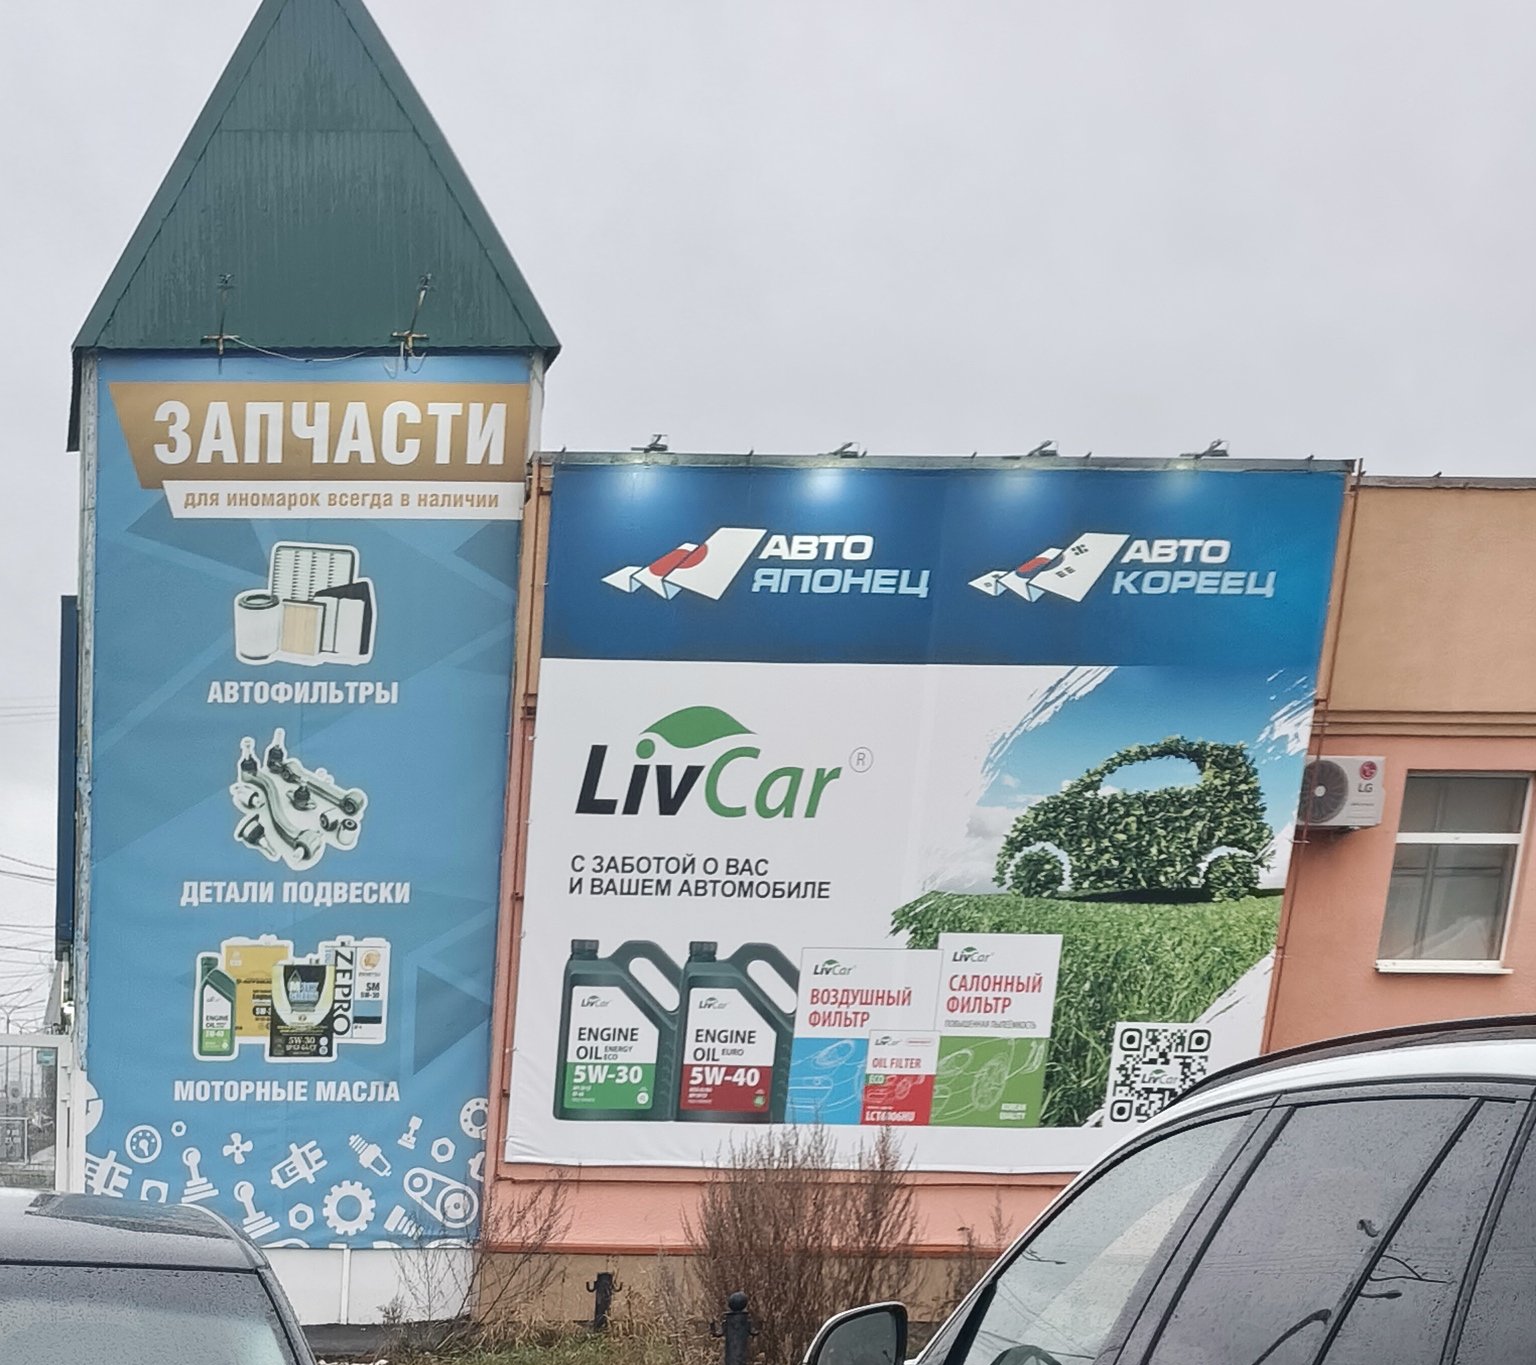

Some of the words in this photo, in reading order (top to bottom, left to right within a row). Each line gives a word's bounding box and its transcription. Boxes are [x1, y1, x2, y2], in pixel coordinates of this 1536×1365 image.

[153, 400, 508, 466] ЗАПЧАСТИ
[184, 490, 220, 508] для
[227, 491, 321, 510] иномарок
[328, 491, 394, 509] всегда
[400, 492, 411, 508] в
[417, 492, 499, 508] наличии
[758, 534, 875, 561] АВТО
[1120, 538, 1232, 565] АВТО
[751, 567, 932, 599] ЯПОНЕЦ
[1111, 570, 1278, 598] КОРЕЕЦ
[207, 679, 399, 705] АВТОФИЛЬТРЫ
[575, 735, 844, 820] LivCar
[1358, 783, 1374, 793] LG
[570, 855, 586, 874] С
[591, 853, 696, 875] ЗАБОТОЙ
[702, 857, 719, 875] О
[725, 857, 770, 877] ВАС
[180, 881, 275, 907] ДЕТАЛИ
[282, 881, 411, 907] ПОДВЕСКИ
[568, 876, 583, 895] И
[590, 878, 672, 897] ВАШЕМ
[677, 879, 832, 899] АВТОМОБИЛЕ
[333, 950, 354, 1035] ZEPRO
[949, 972, 1043, 994] САЛОННЫЙ
[809, 986, 913, 1009] ВОЗДУШНЫЙ
[946, 995, 1012, 1015] ФИЛЬТР
[808, 1010, 871, 1029] ФИЛЬТР
[577, 1026, 640, 1043] ENGINE
[694, 1028, 757, 1045] ENGINE
[576, 1046, 603, 1061] OIL
[693, 1047, 720, 1062] OIL
[721, 1048, 745, 1057] EURO
[872, 1057, 888, 1068] OIL
[890, 1058, 922, 1069] FILTER
[573, 1065, 643, 1085] 5W-30
[689, 1066, 761, 1087] 5W-40
[174, 1080, 309, 1103] МОТОРНЫЕ
[315, 1080, 401, 1103] МАСЛА
